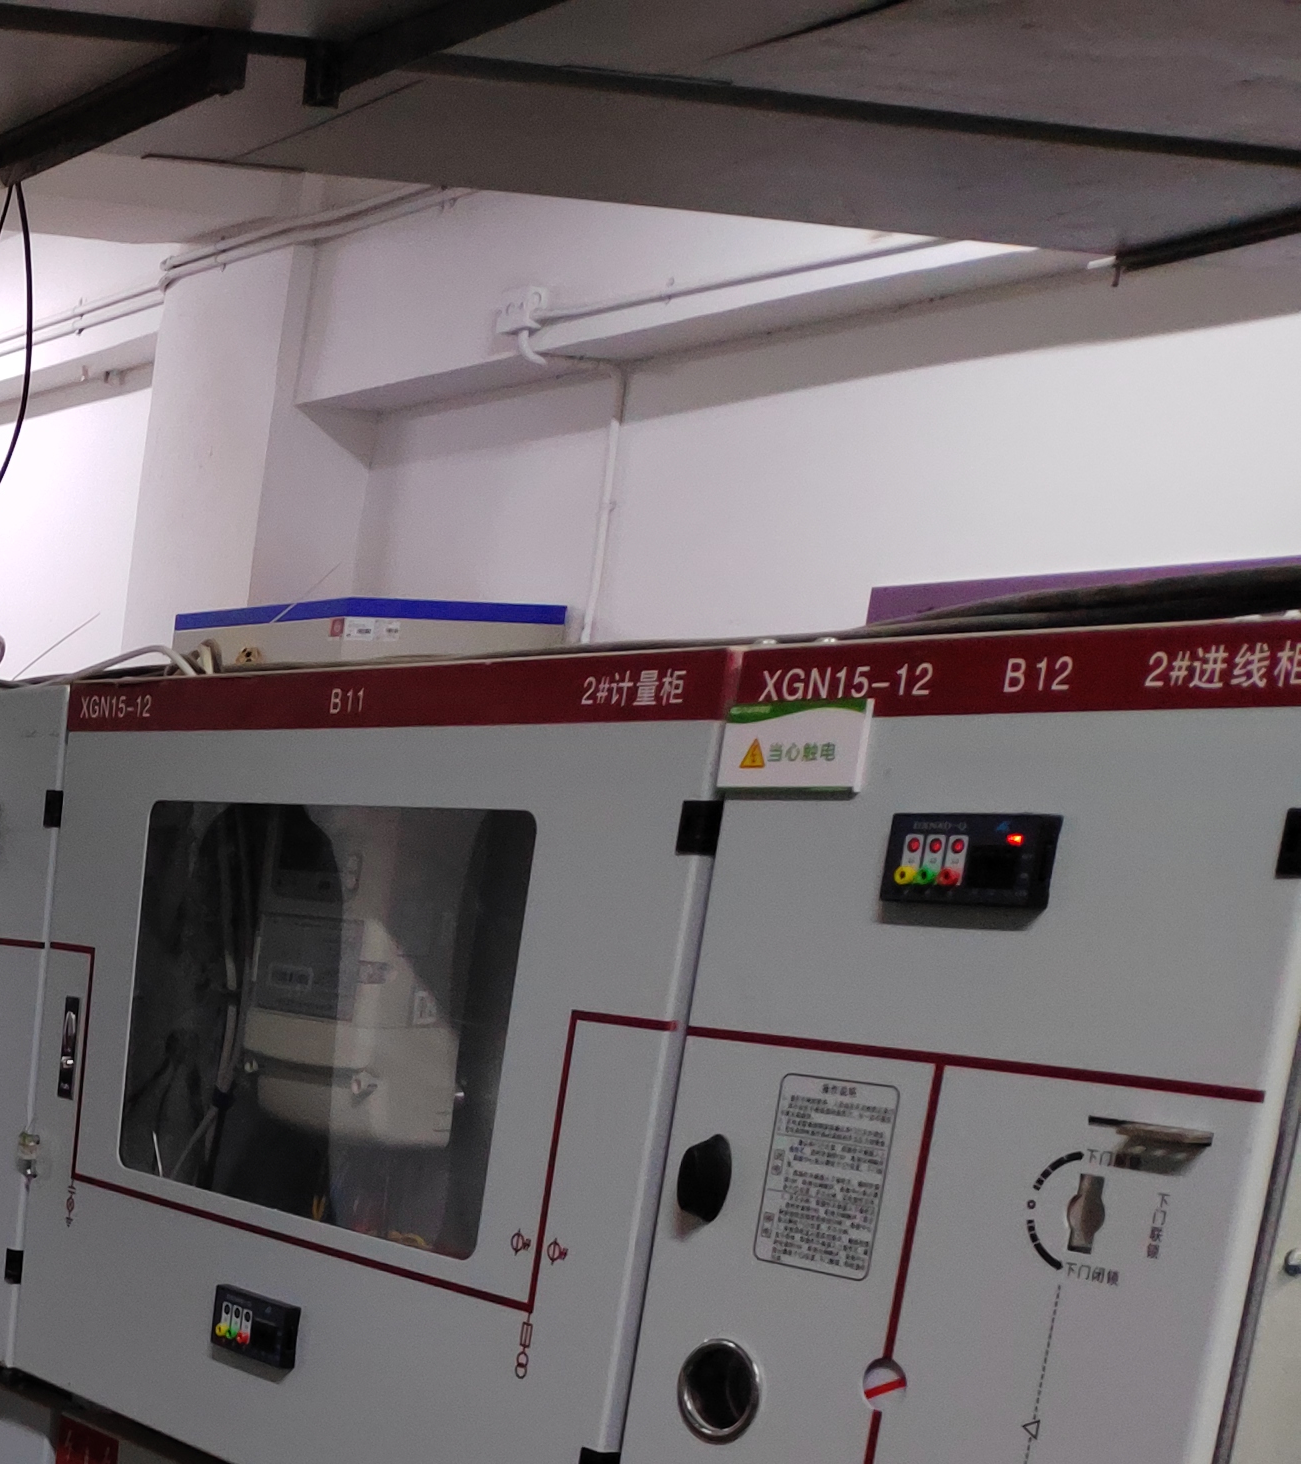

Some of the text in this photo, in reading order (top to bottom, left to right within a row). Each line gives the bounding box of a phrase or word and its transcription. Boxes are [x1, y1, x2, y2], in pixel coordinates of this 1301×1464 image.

[80, 668, 687, 718] XGN15-12 B11 2#计量柜
[758, 662, 934, 702] XGN15-12
[1003, 656, 1074, 693] B12
[767, 741, 836, 762] 当心触电
